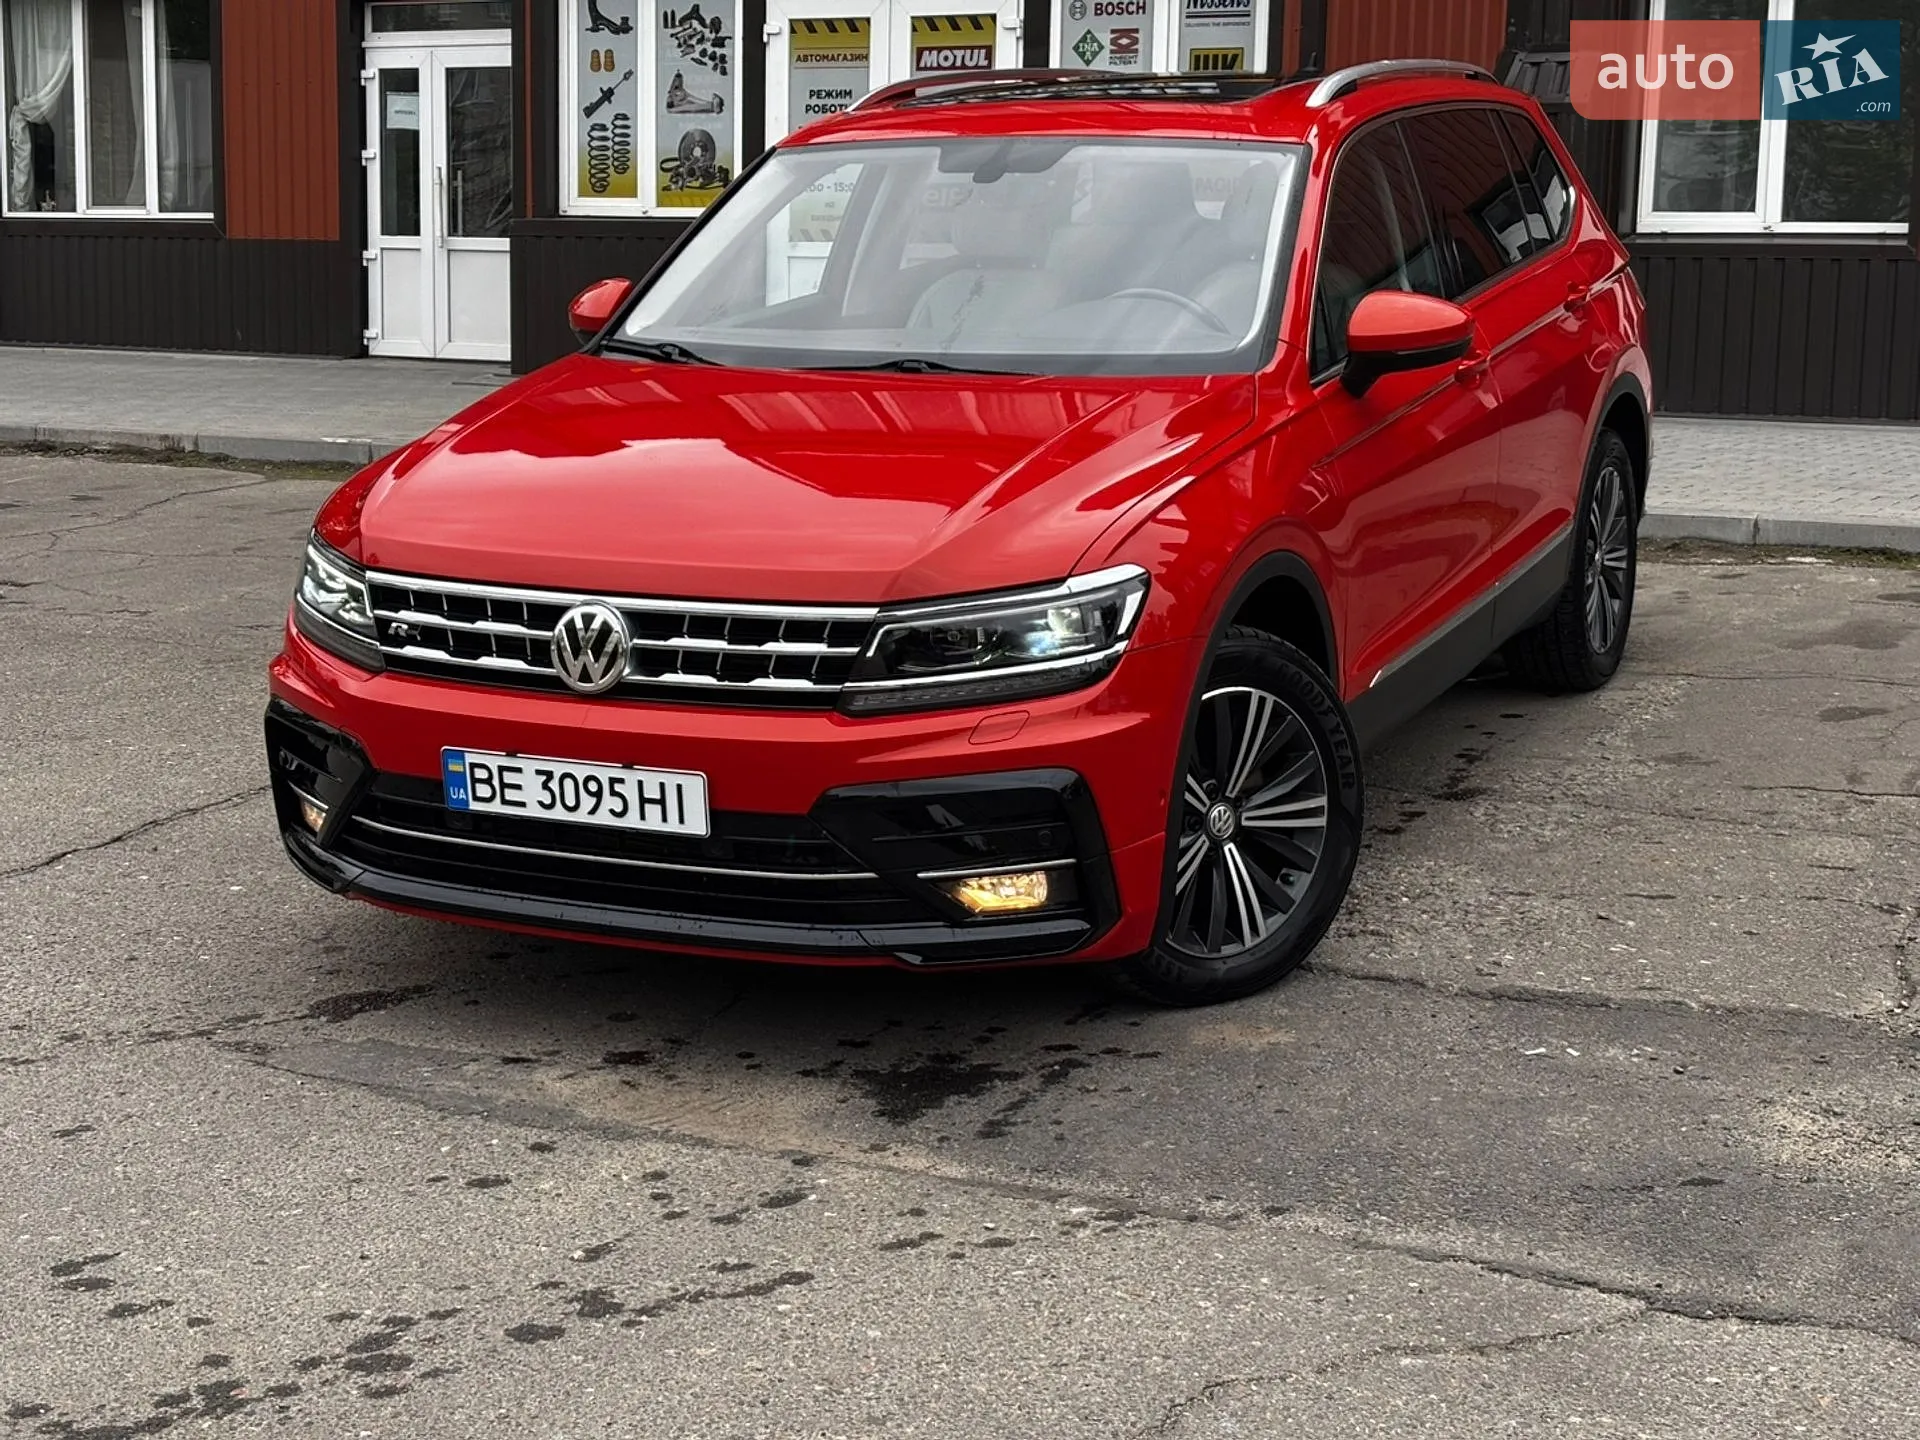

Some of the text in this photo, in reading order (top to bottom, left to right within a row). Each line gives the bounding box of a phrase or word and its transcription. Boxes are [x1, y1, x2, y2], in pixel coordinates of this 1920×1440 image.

[1094, 1, 1146, 16] BOSCH
[796, 53, 869, 63] АВТОМАГАЗИН
[919, 49, 989, 67] MOTUL
[809, 89, 853, 100] РЕЖИМ
[450, 786, 467, 801] UA
[469, 762, 685, 825] BE 3095 HI
